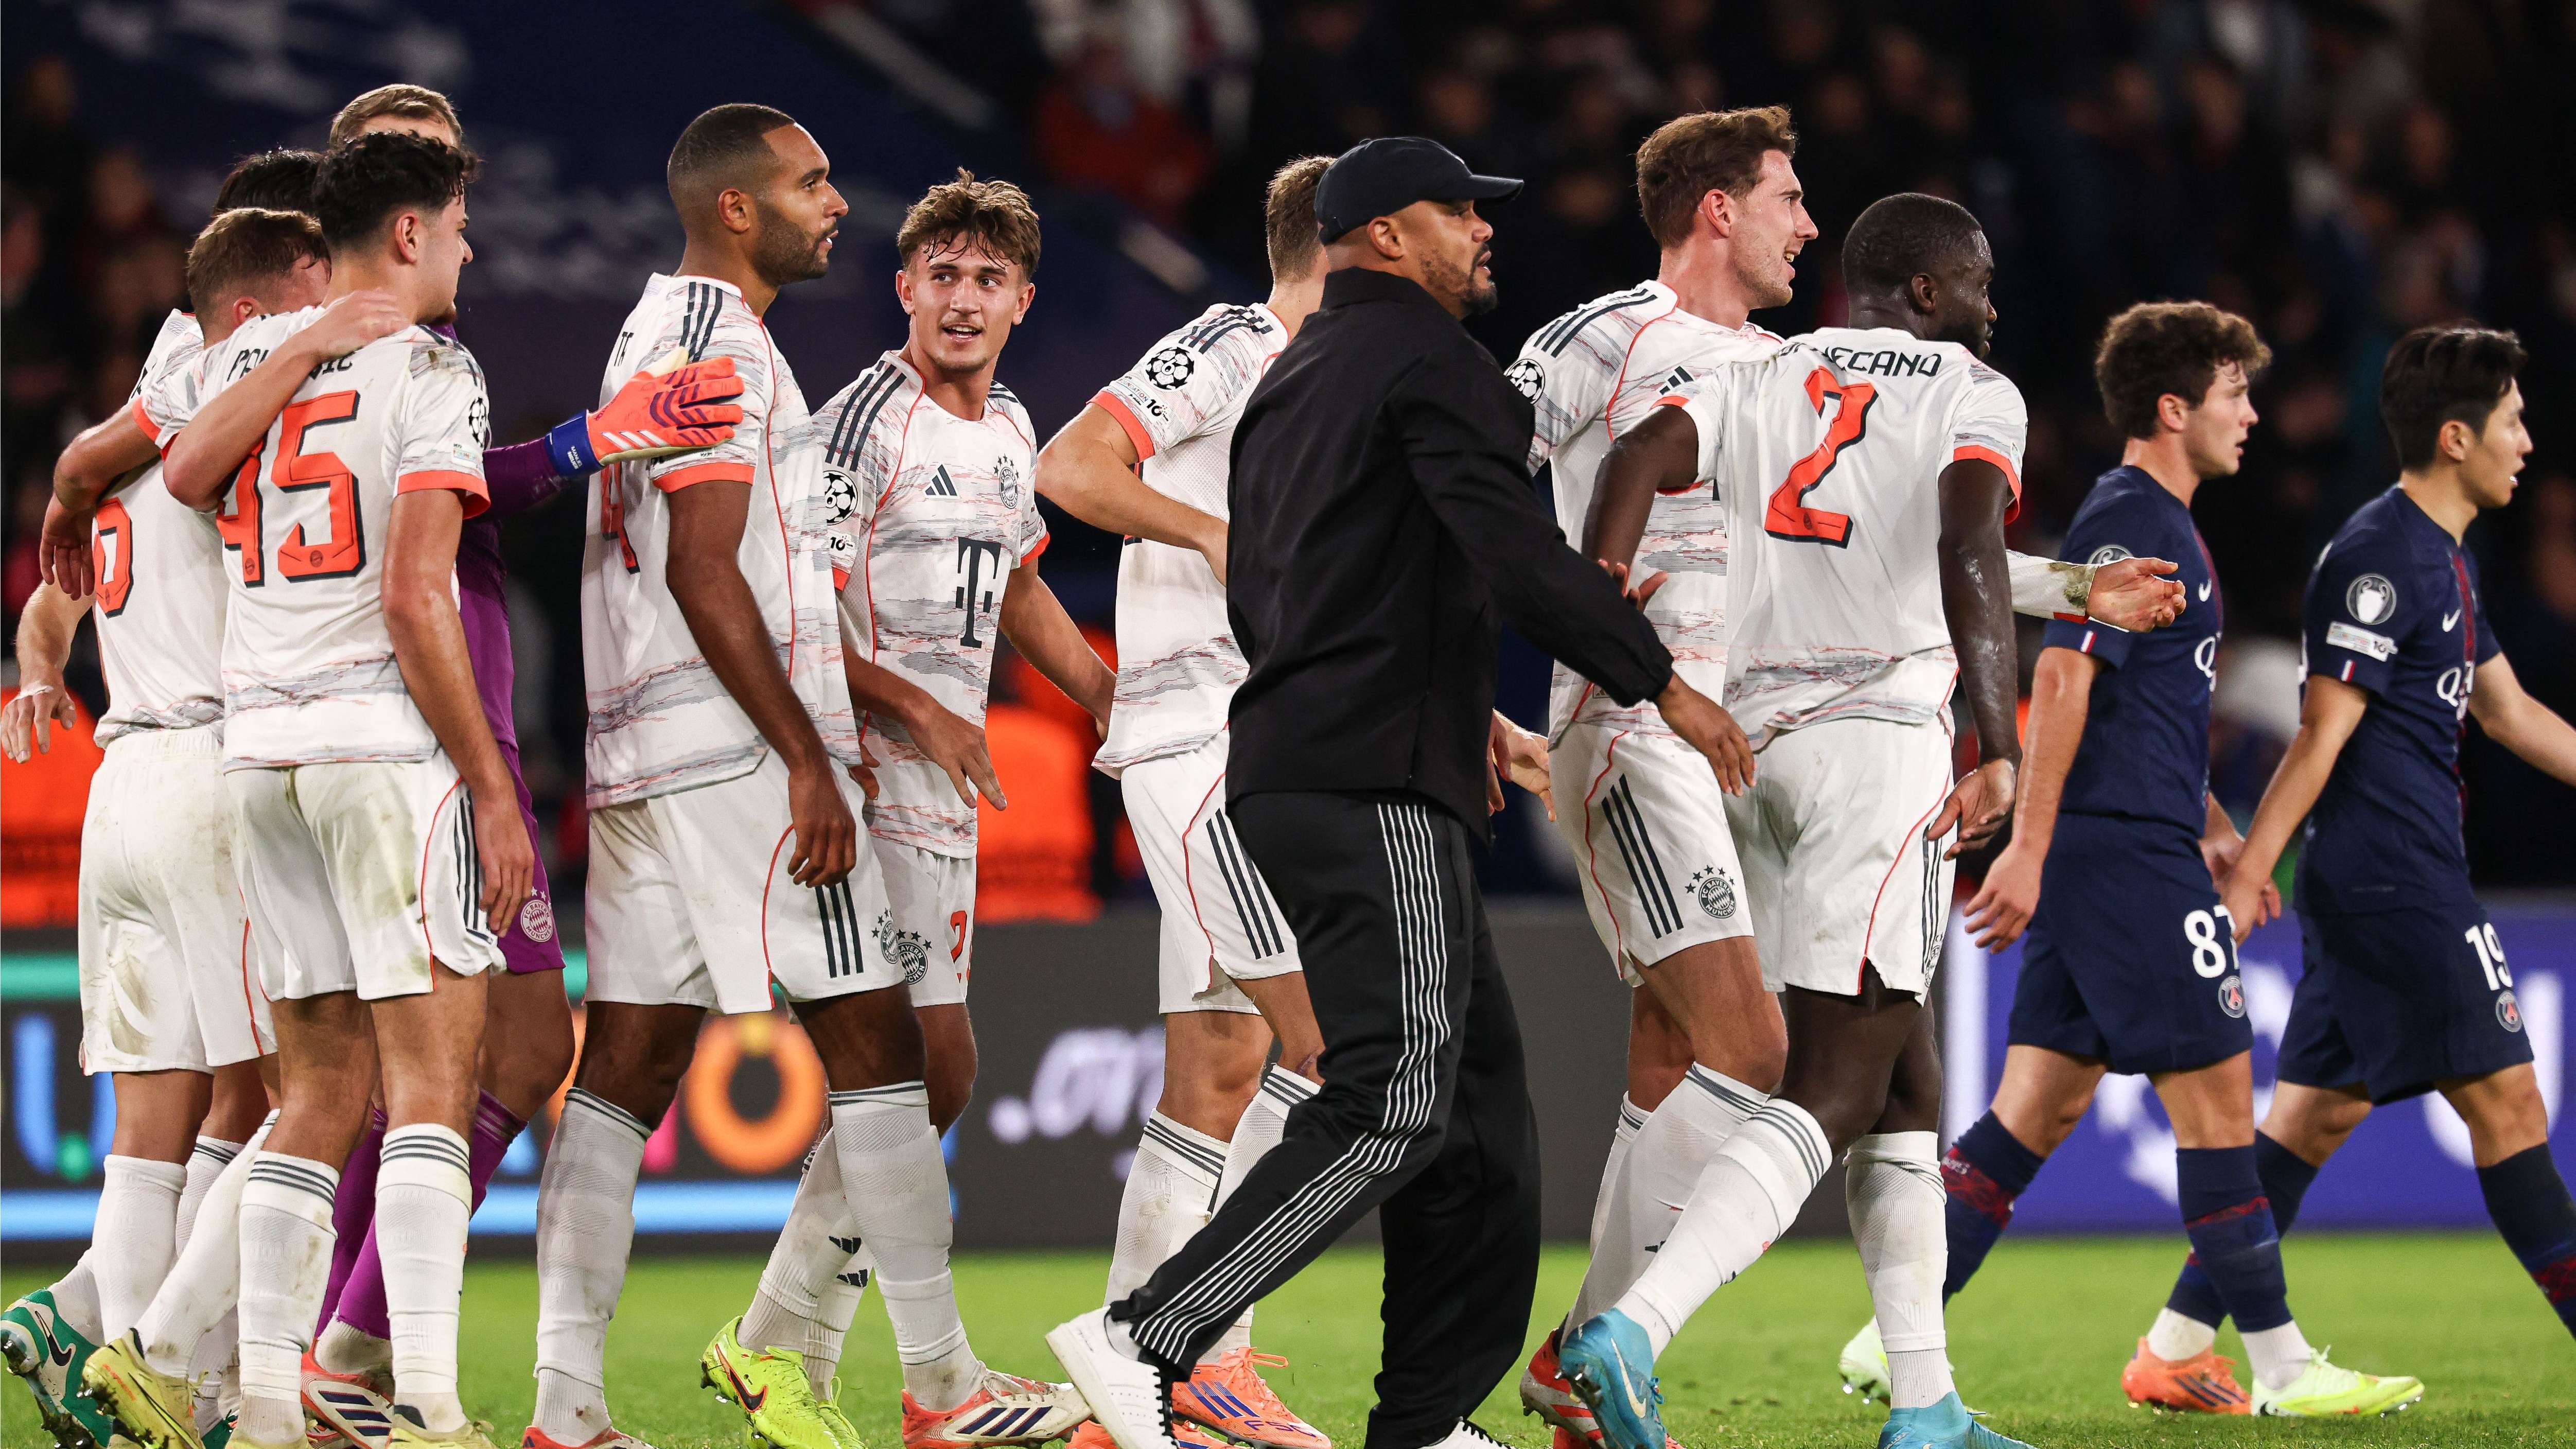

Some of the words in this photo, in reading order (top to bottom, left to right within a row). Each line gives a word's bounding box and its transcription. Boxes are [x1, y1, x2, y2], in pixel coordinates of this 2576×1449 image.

[217, 390, 365, 587] 45
[1764, 365, 1878, 549] 2
[830, 536, 846, 551] 10
[901, 945, 924, 959] AYERN
[907, 965, 925, 982] CHEN
[2184, 904, 2239, 979] 87
[2465, 922, 2513, 991] 19
